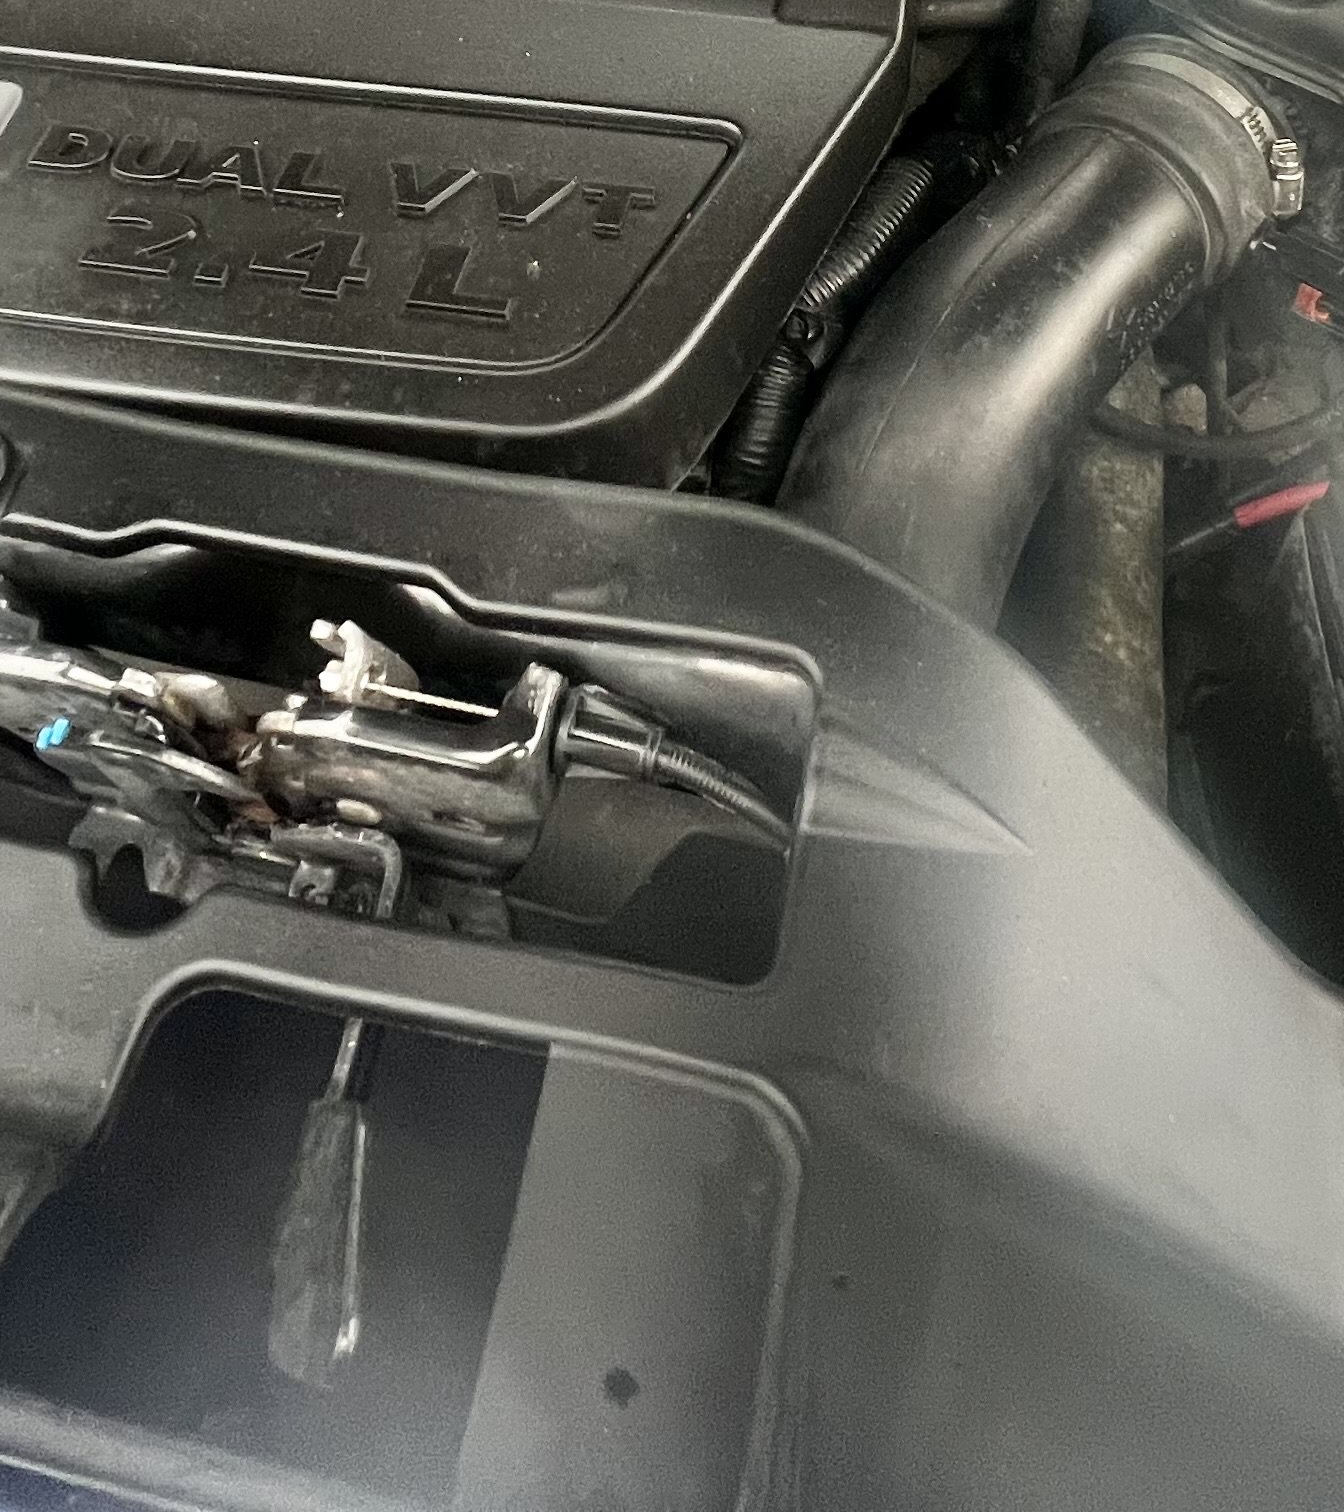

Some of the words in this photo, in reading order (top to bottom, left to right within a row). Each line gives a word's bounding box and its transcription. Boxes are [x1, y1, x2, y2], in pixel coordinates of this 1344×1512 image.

[27, 126, 345, 206] DUAL
[391, 160, 655, 235] VVT
[78, 206, 367, 298] 2.4
[405, 244, 510, 320] L
